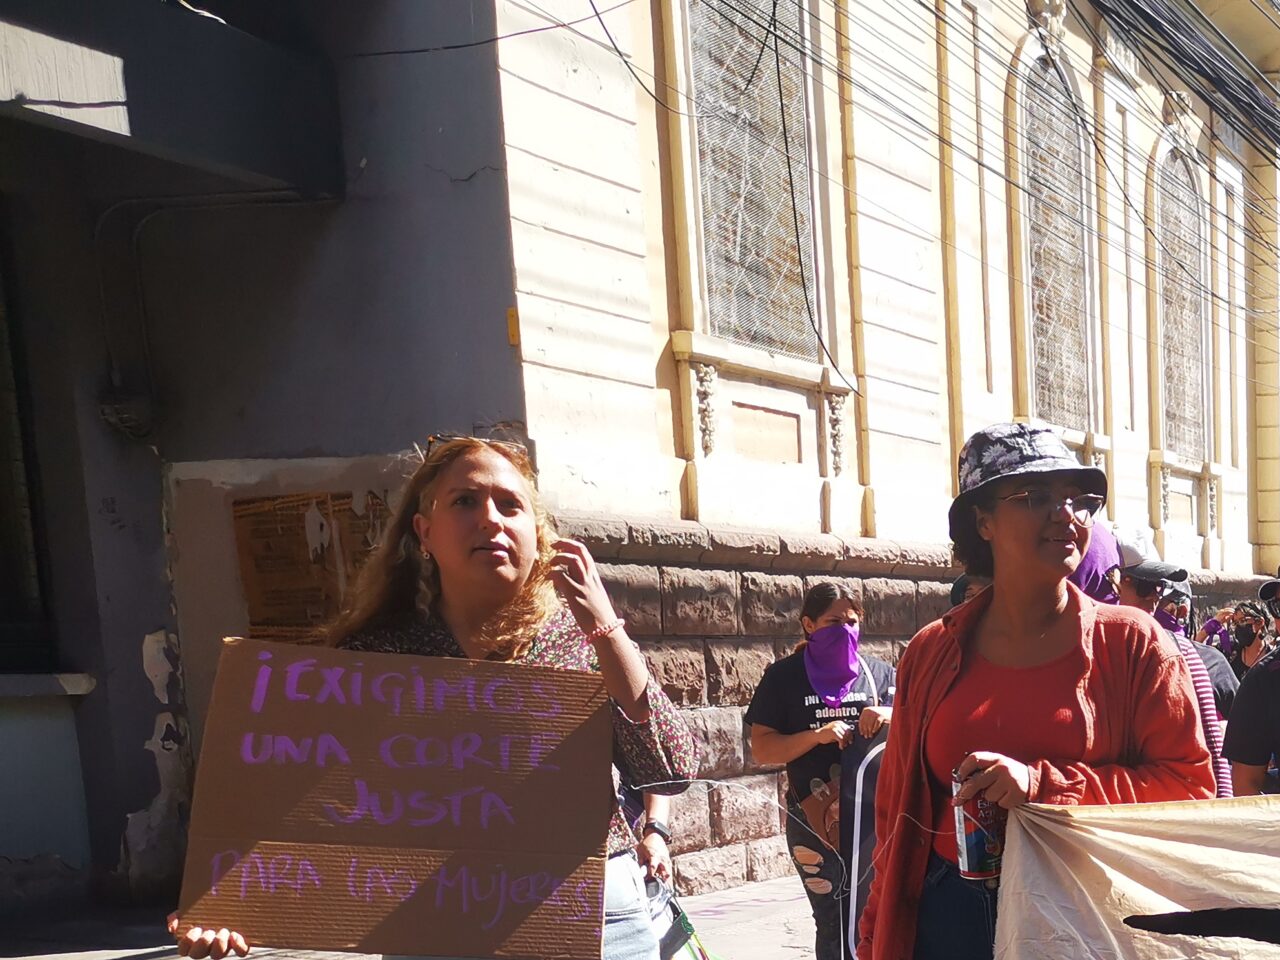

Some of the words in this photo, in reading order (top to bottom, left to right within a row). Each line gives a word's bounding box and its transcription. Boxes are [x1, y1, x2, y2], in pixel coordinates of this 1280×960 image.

[240, 732, 352, 768] UNA
[379, 732, 561, 770] CORTE
[324, 779, 516, 828] JUSTA
[211, 849, 322, 900] PARA
